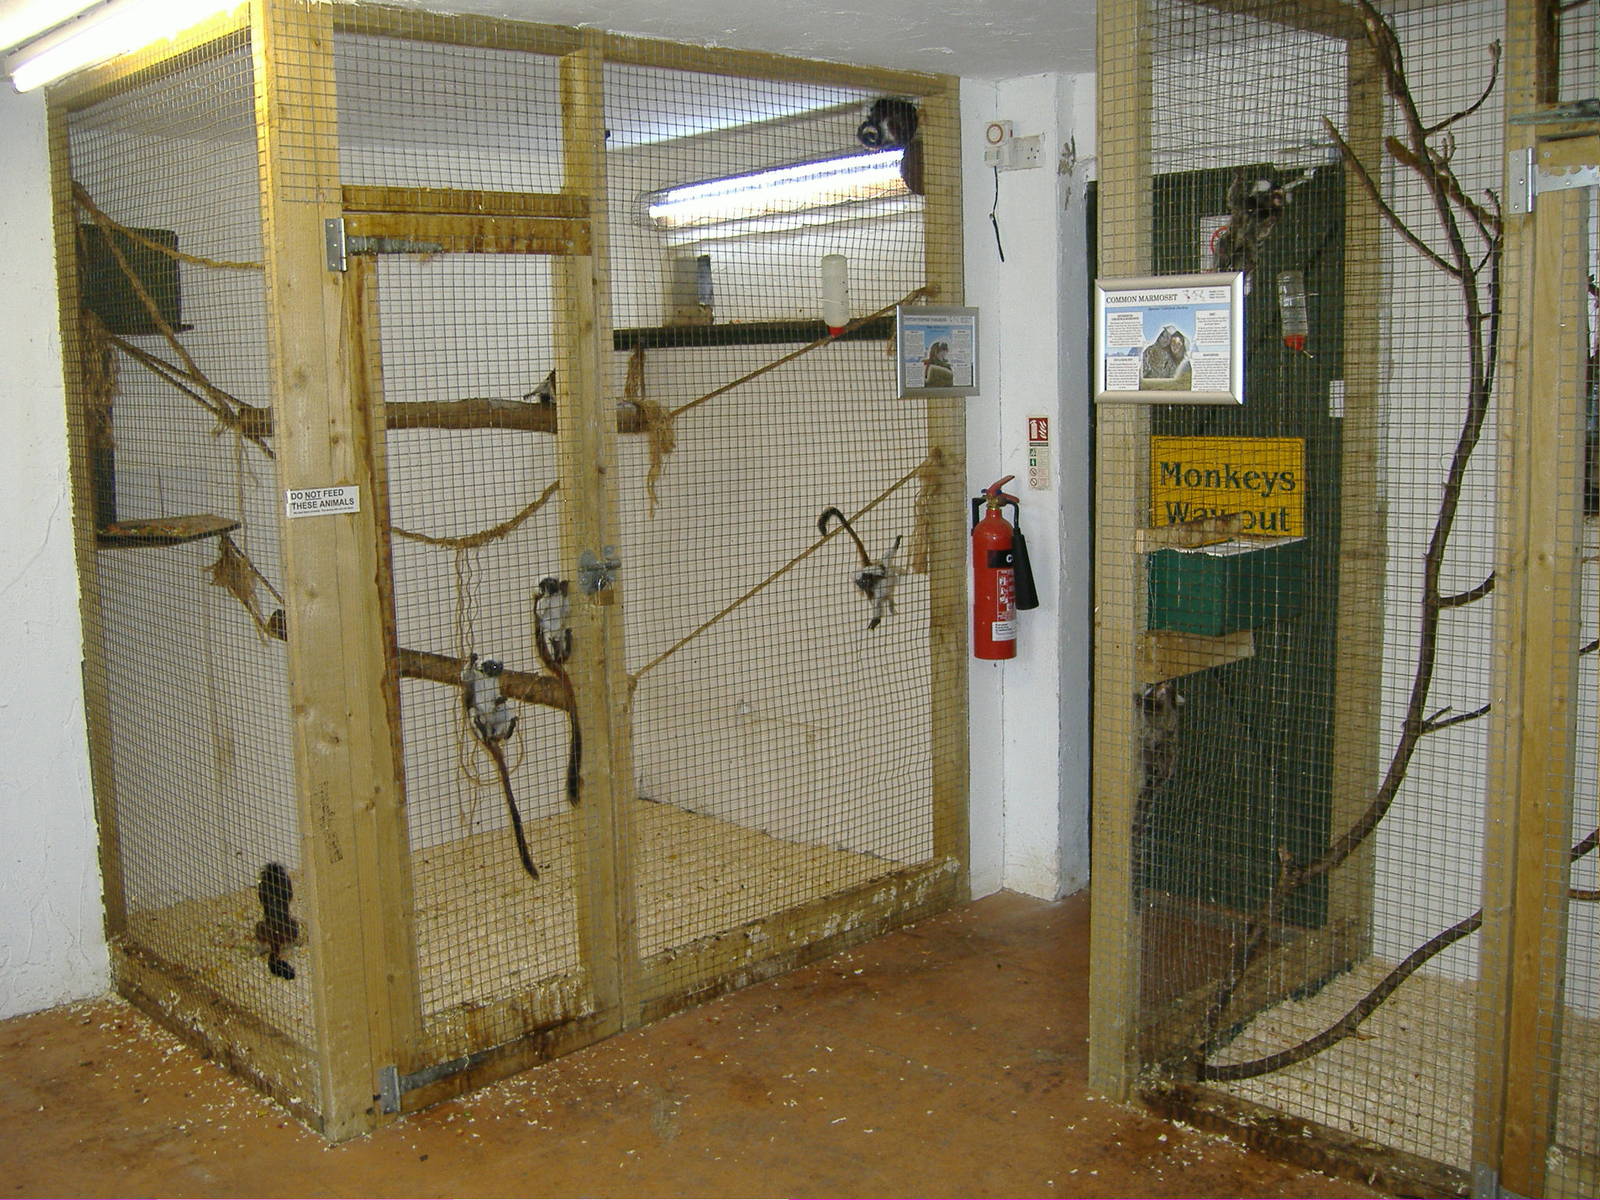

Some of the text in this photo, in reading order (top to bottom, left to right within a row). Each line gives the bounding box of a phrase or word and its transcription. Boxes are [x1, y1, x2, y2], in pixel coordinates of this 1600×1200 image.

[1106, 294, 1178, 304] COMMON MARMOSET
[1160, 462, 1296, 497] Monkeys
[291, 489, 344, 500] DO NOT FEED
[291, 501, 318, 510] THESE
[319, 498, 355, 508] ANIMALS
[1244, 507, 1291, 532] out
